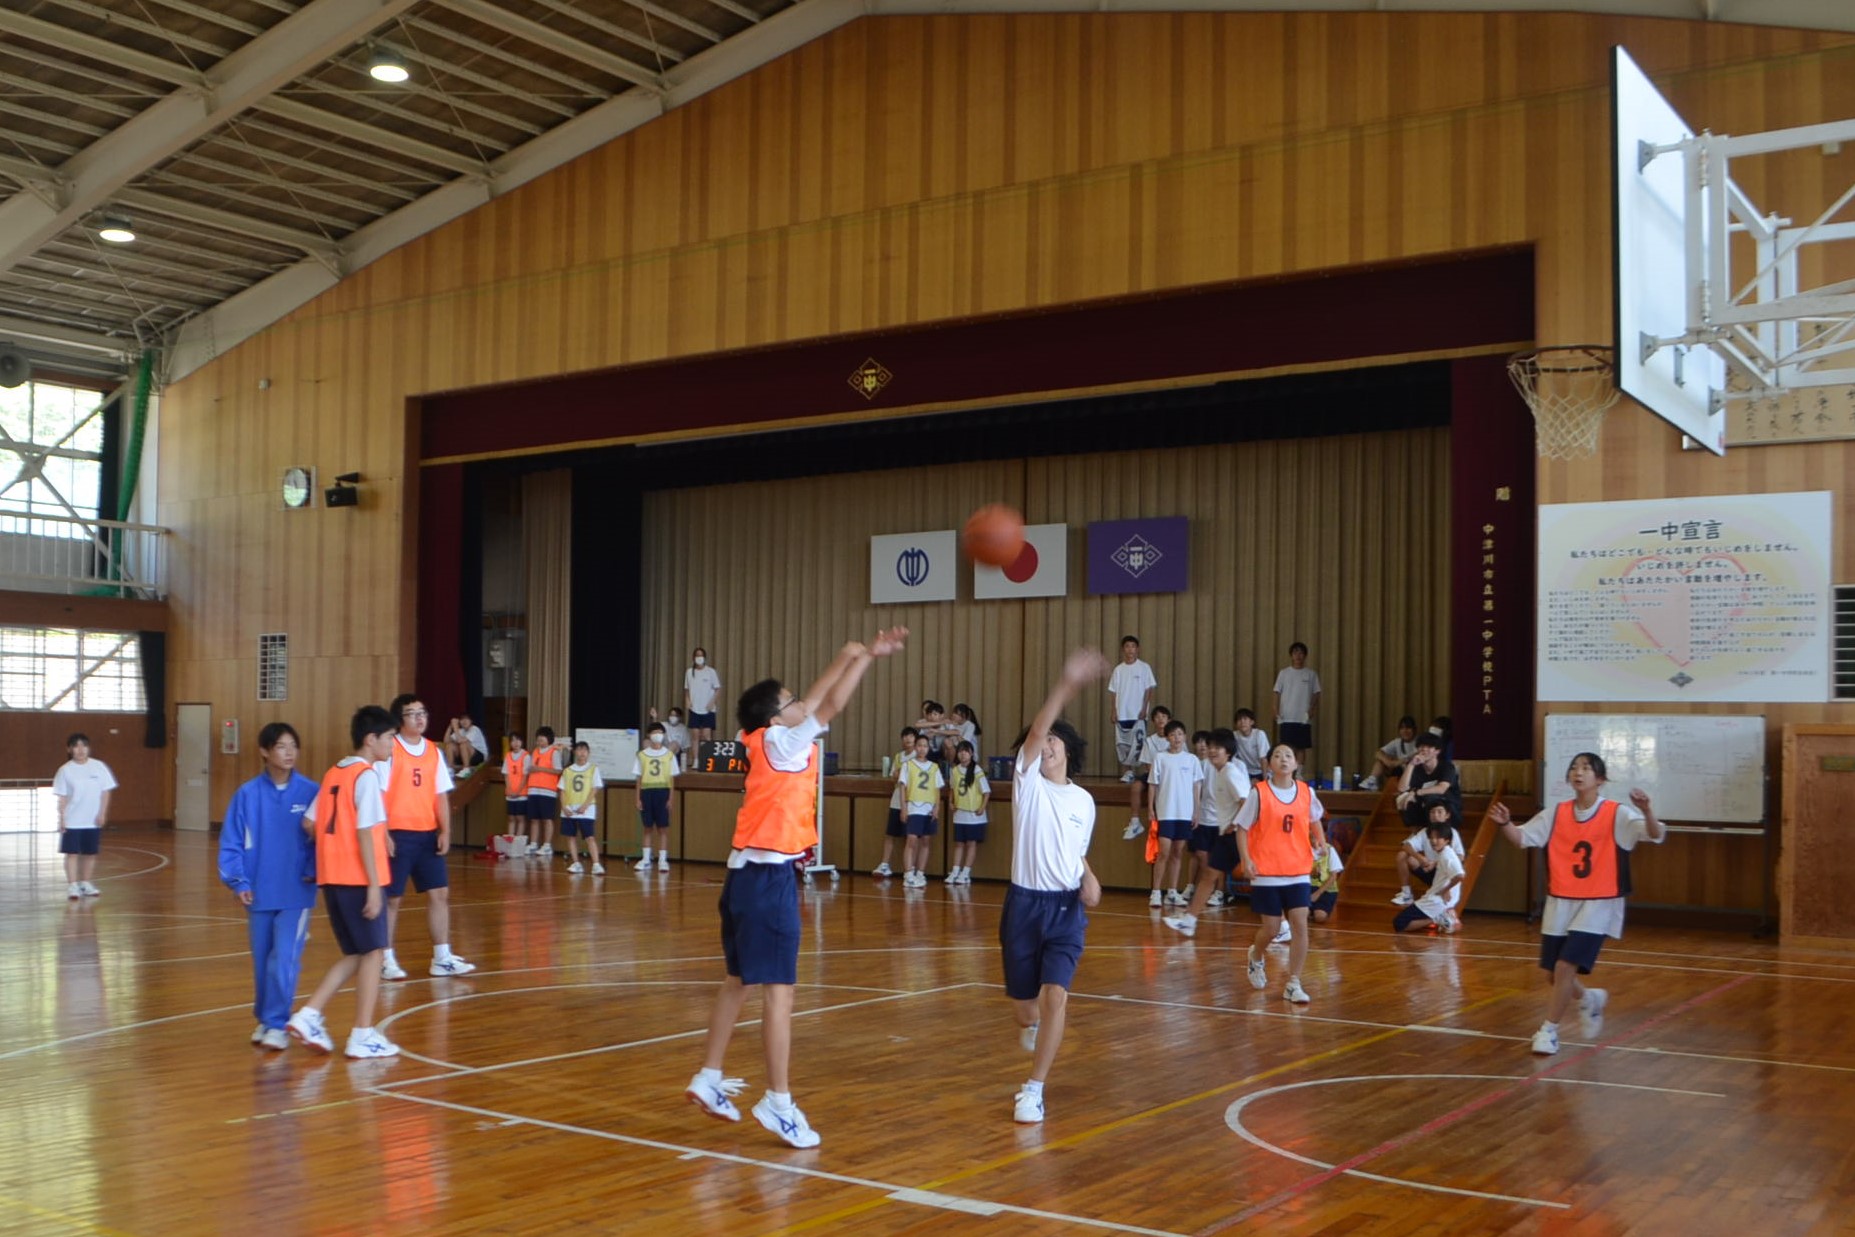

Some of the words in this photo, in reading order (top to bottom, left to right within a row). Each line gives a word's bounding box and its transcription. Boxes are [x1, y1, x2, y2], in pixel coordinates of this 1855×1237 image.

[1639, 520, 1723, 541] 一中宣言
[649, 759, 661, 776] 3
[706, 758, 714, 772] 3
[413, 768, 422, 787] 5
[573, 774, 584, 792] 6
[918, 771, 930, 790] 2
[324, 785, 340, 834] 1
[1282, 814, 1294, 834] 6
[1572, 840, 1593, 879] 3
